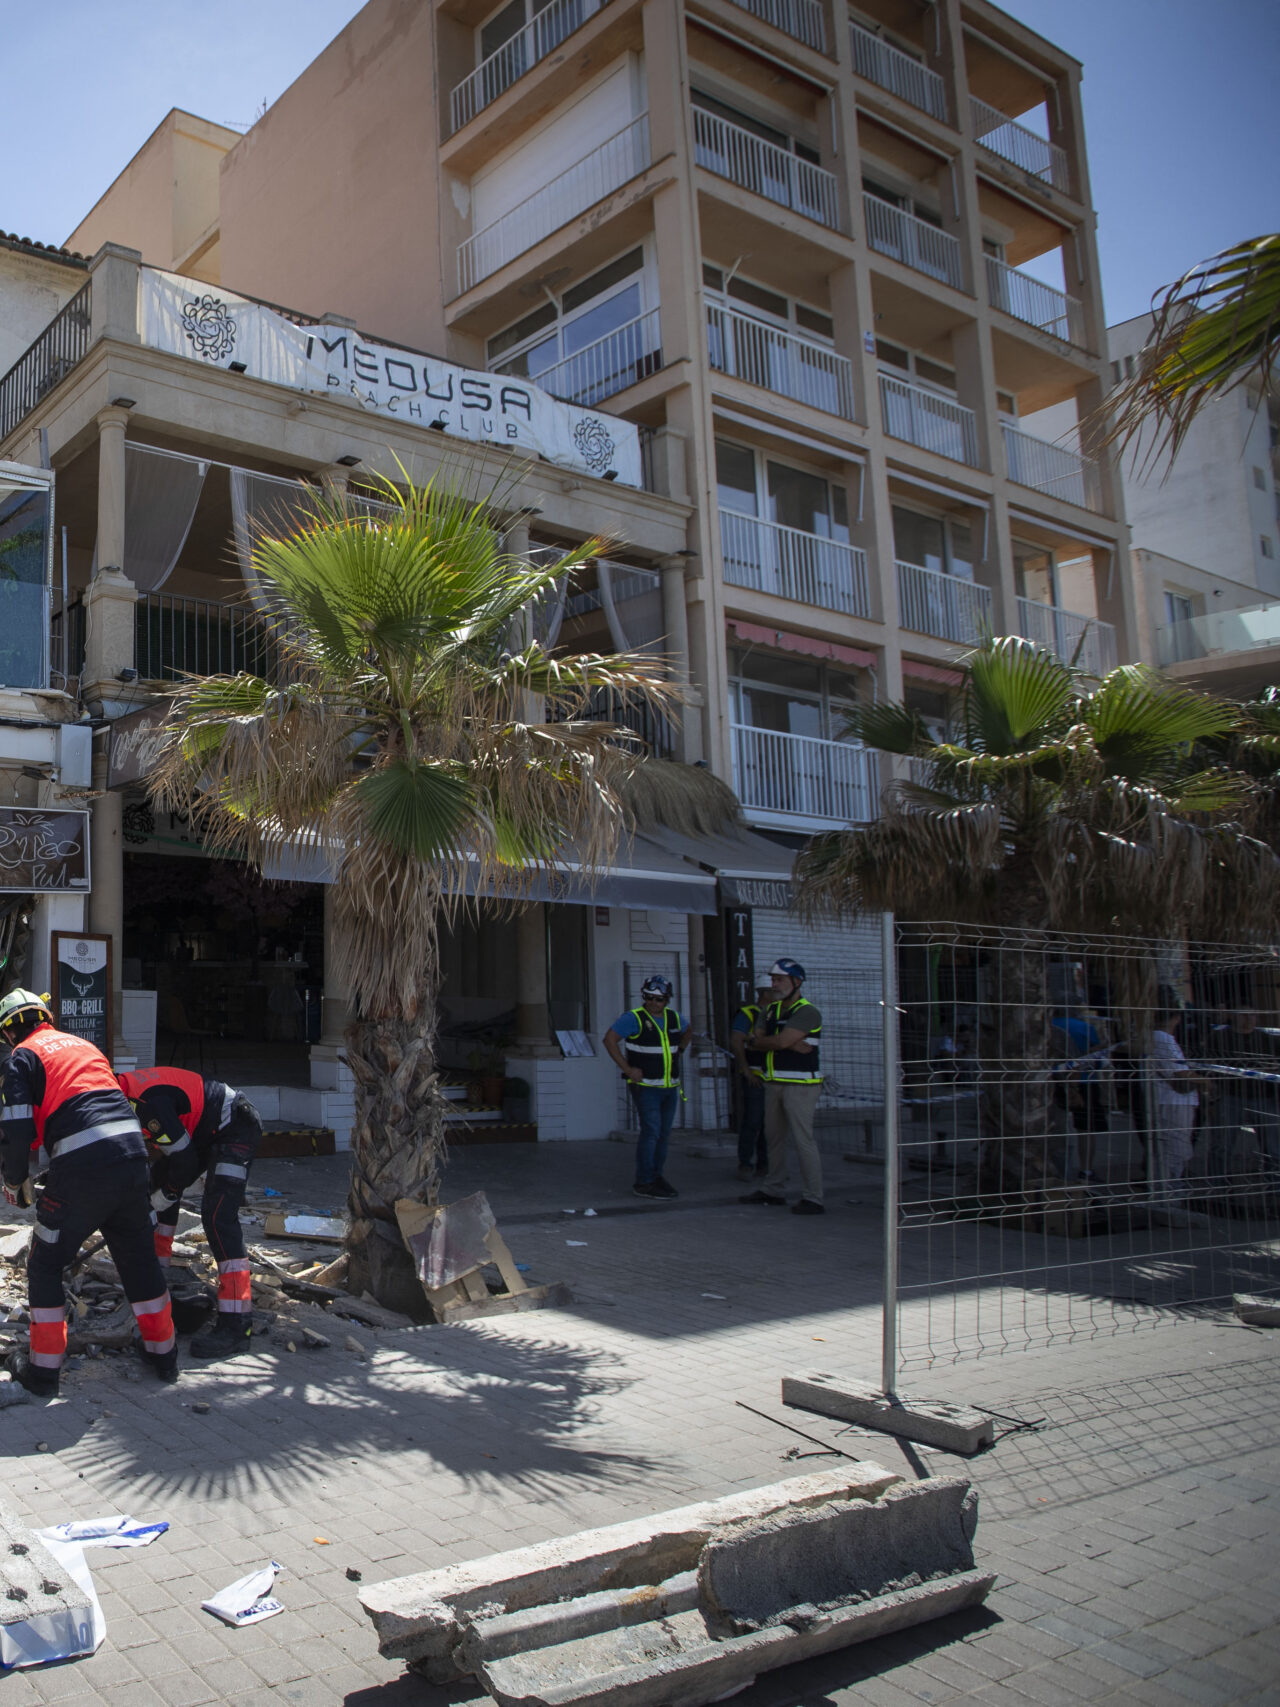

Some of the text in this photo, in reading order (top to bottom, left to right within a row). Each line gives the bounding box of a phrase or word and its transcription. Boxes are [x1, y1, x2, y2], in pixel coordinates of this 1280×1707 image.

[306, 336, 531, 421] MEDUSA
[438, 409, 518, 438] CLUB
[61, 999, 104, 1016] BBQ GRILL
[43, 1041, 62, 1054] DE
